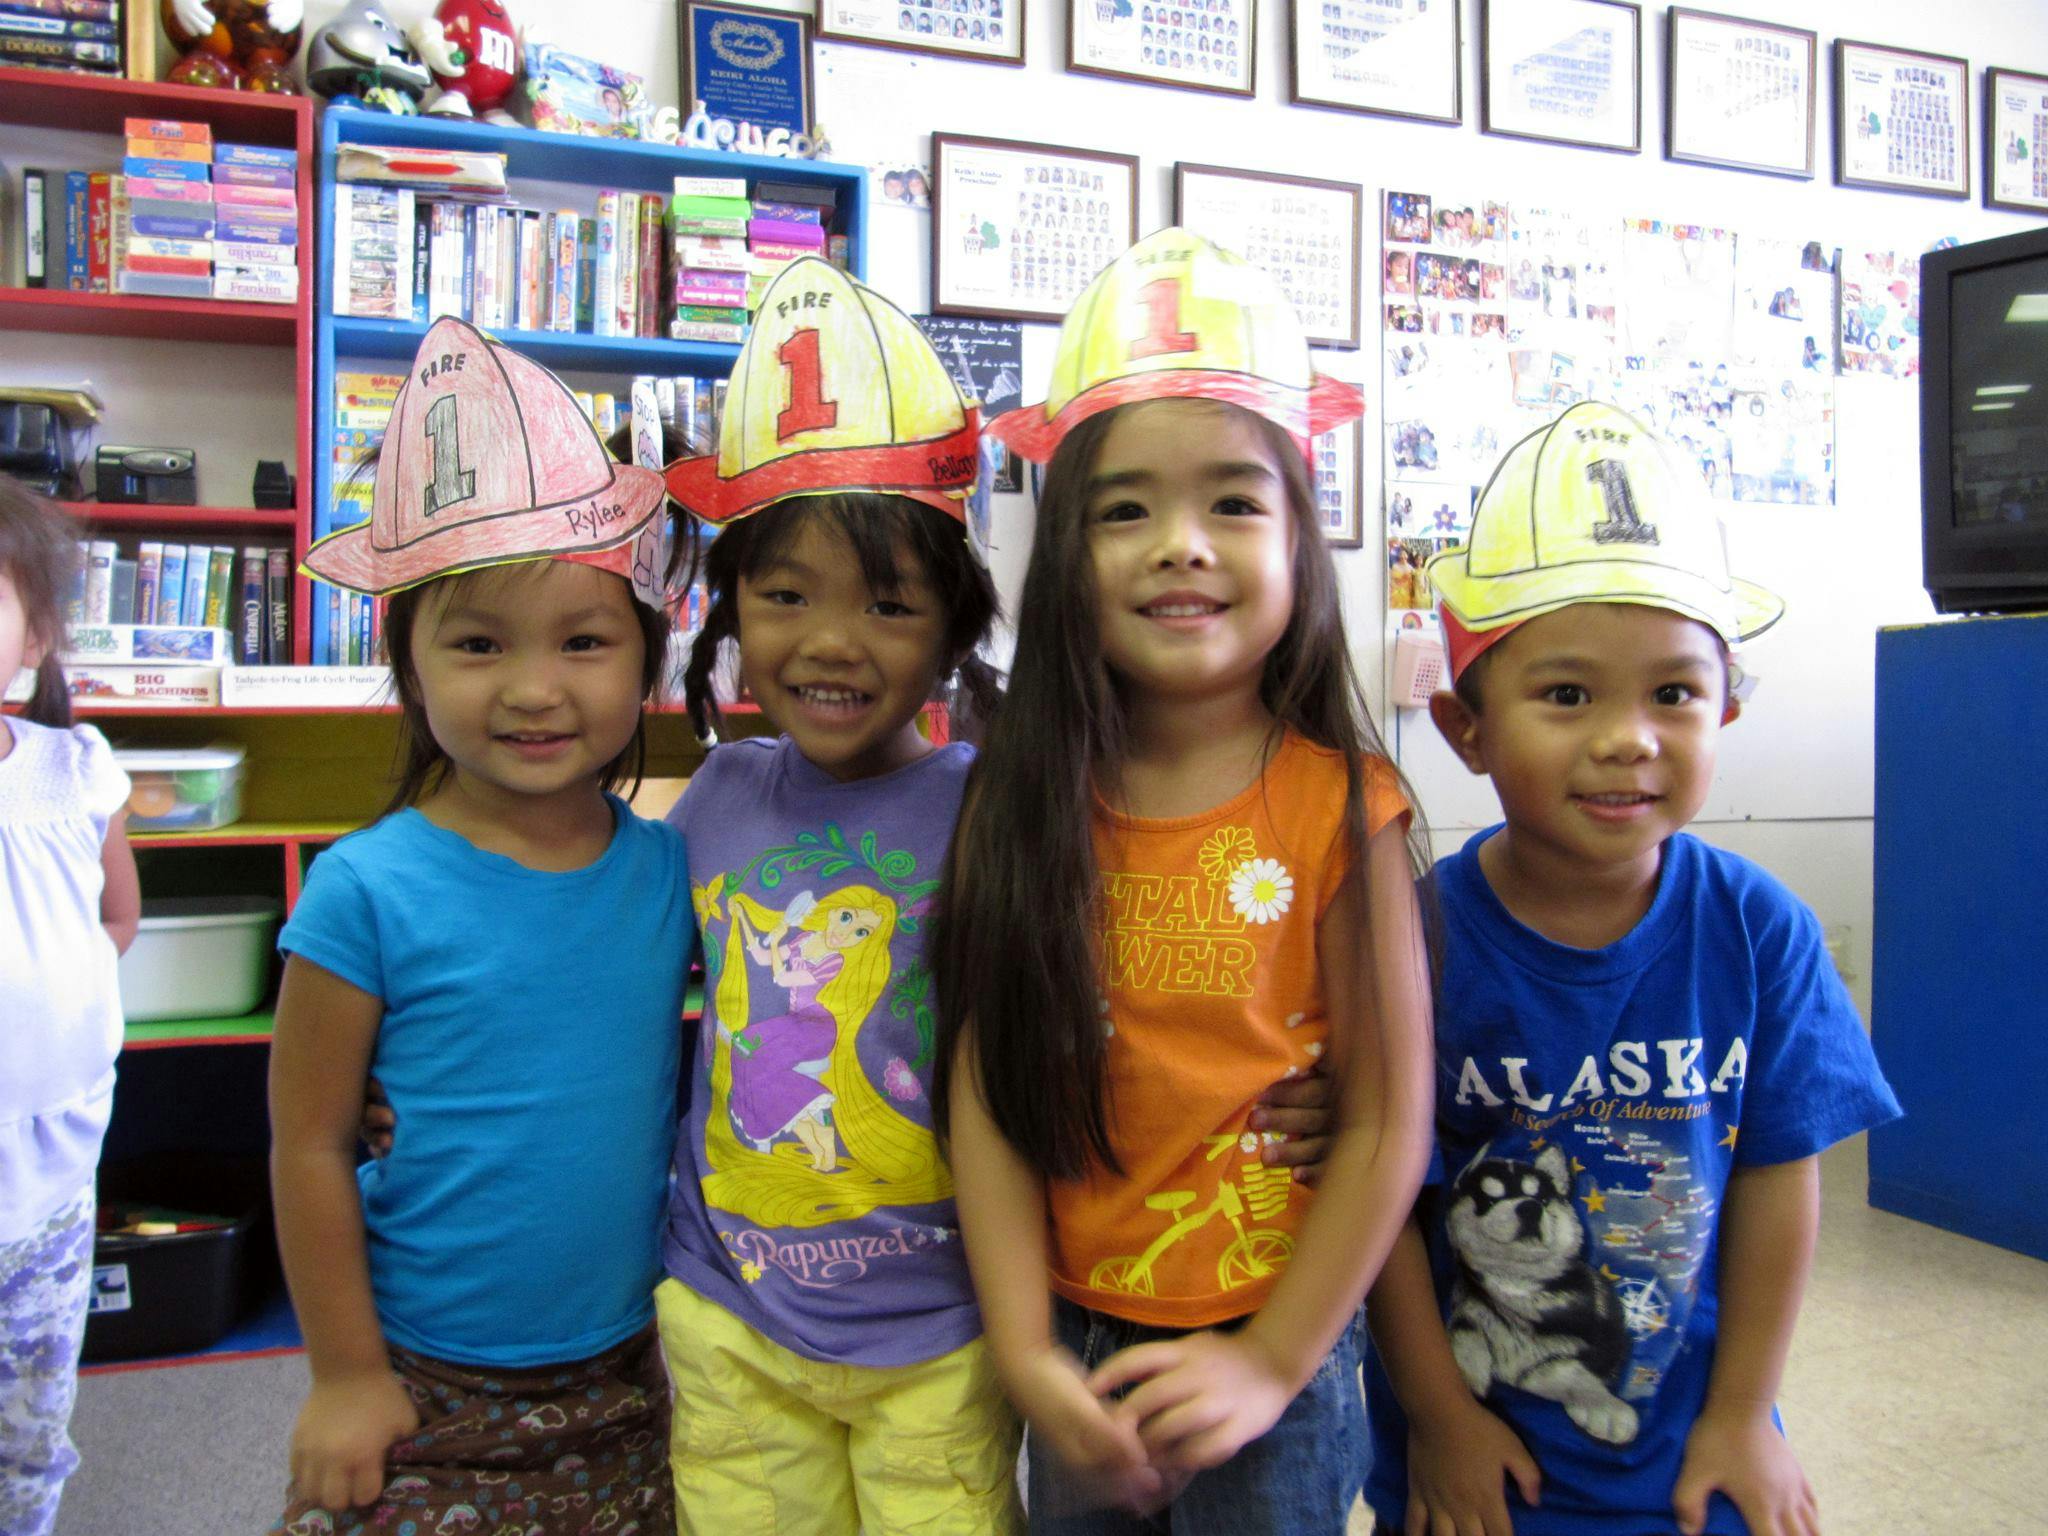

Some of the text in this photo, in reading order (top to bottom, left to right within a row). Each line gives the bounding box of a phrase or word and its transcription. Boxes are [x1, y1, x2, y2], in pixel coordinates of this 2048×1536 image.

[480, 26, 514, 75] m
[710, 69, 787, 86] KEIKI ALOHA
[228, 247, 279, 262] Franklin
[230, 282, 281, 296] Franklin
[776, 290, 833, 319] FIRE
[420, 353, 467, 388] FIRE
[776, 328, 838, 442] 1
[1574, 428, 1633, 445] FIRE
[424, 393, 476, 518] 1
[1586, 458, 1661, 547] 1
[564, 500, 627, 540] Rylee
[244, 600, 261, 655] CINDERELLA
[134, 673, 166, 685] BIG
[134, 687, 209, 697] MACHINES
[304, 676, 320, 684] Life
[323, 676, 345, 685] Cycle
[1103, 930, 1257, 998] WER
[1454, 1036, 1748, 1112] ALASKA
[1589, 1098, 1615, 1121] Of
[1616, 1100, 1712, 1122] Adventure
[1573, 1123, 1602, 1134] Nome
[736, 1226, 916, 1289] Rapunzel
